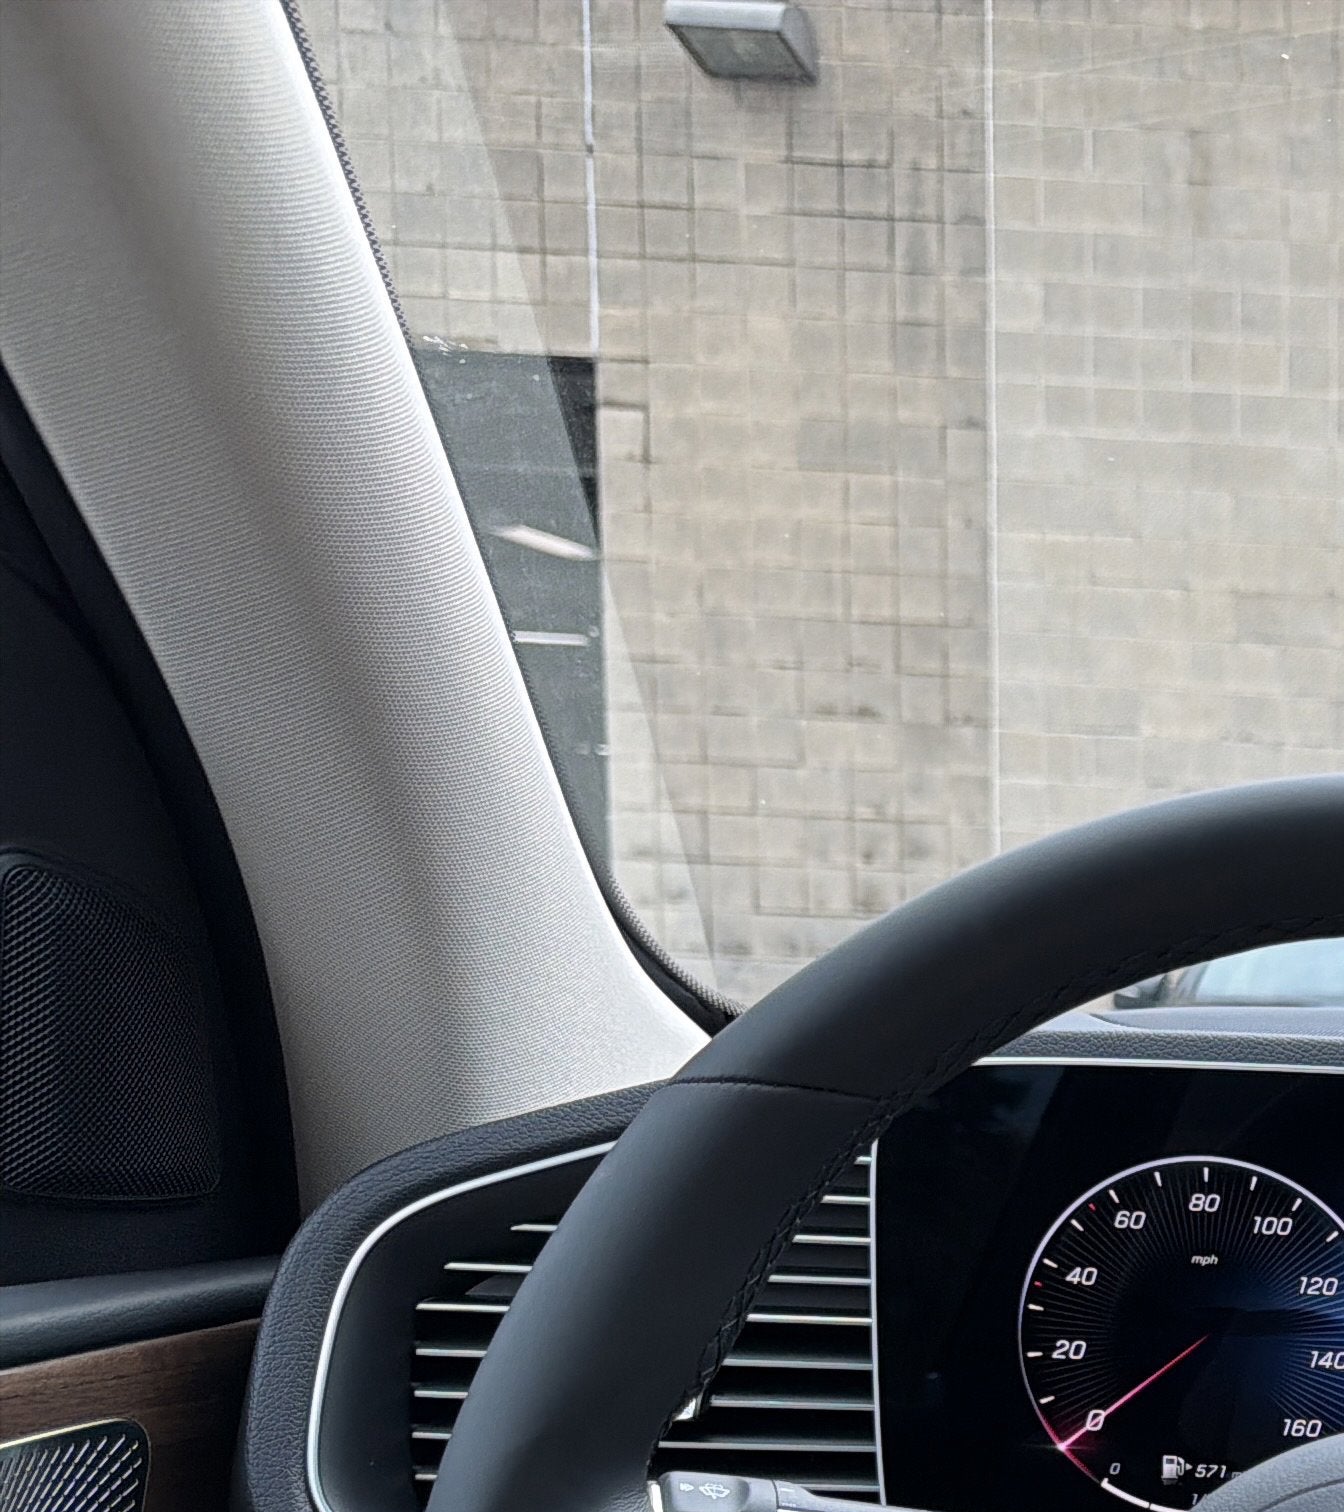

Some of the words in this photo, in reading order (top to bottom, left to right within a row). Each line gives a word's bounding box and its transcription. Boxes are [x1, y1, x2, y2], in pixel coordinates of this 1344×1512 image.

[1188, 1194, 1221, 1212] 80
[1114, 1211, 1146, 1230] 60
[1252, 1217, 1293, 1236] 100
[1191, 1254, 1219, 1267] mph
[1066, 1267, 1098, 1286] 40
[1298, 1277, 1339, 1297] 120
[1051, 1341, 1087, 1360] 20
[1085, 1409, 1106, 1432] 0
[1282, 1418, 1322, 1438] 160
[1109, 1462, 1122, 1476] 0
[1194, 1464, 1228, 1479] 571
